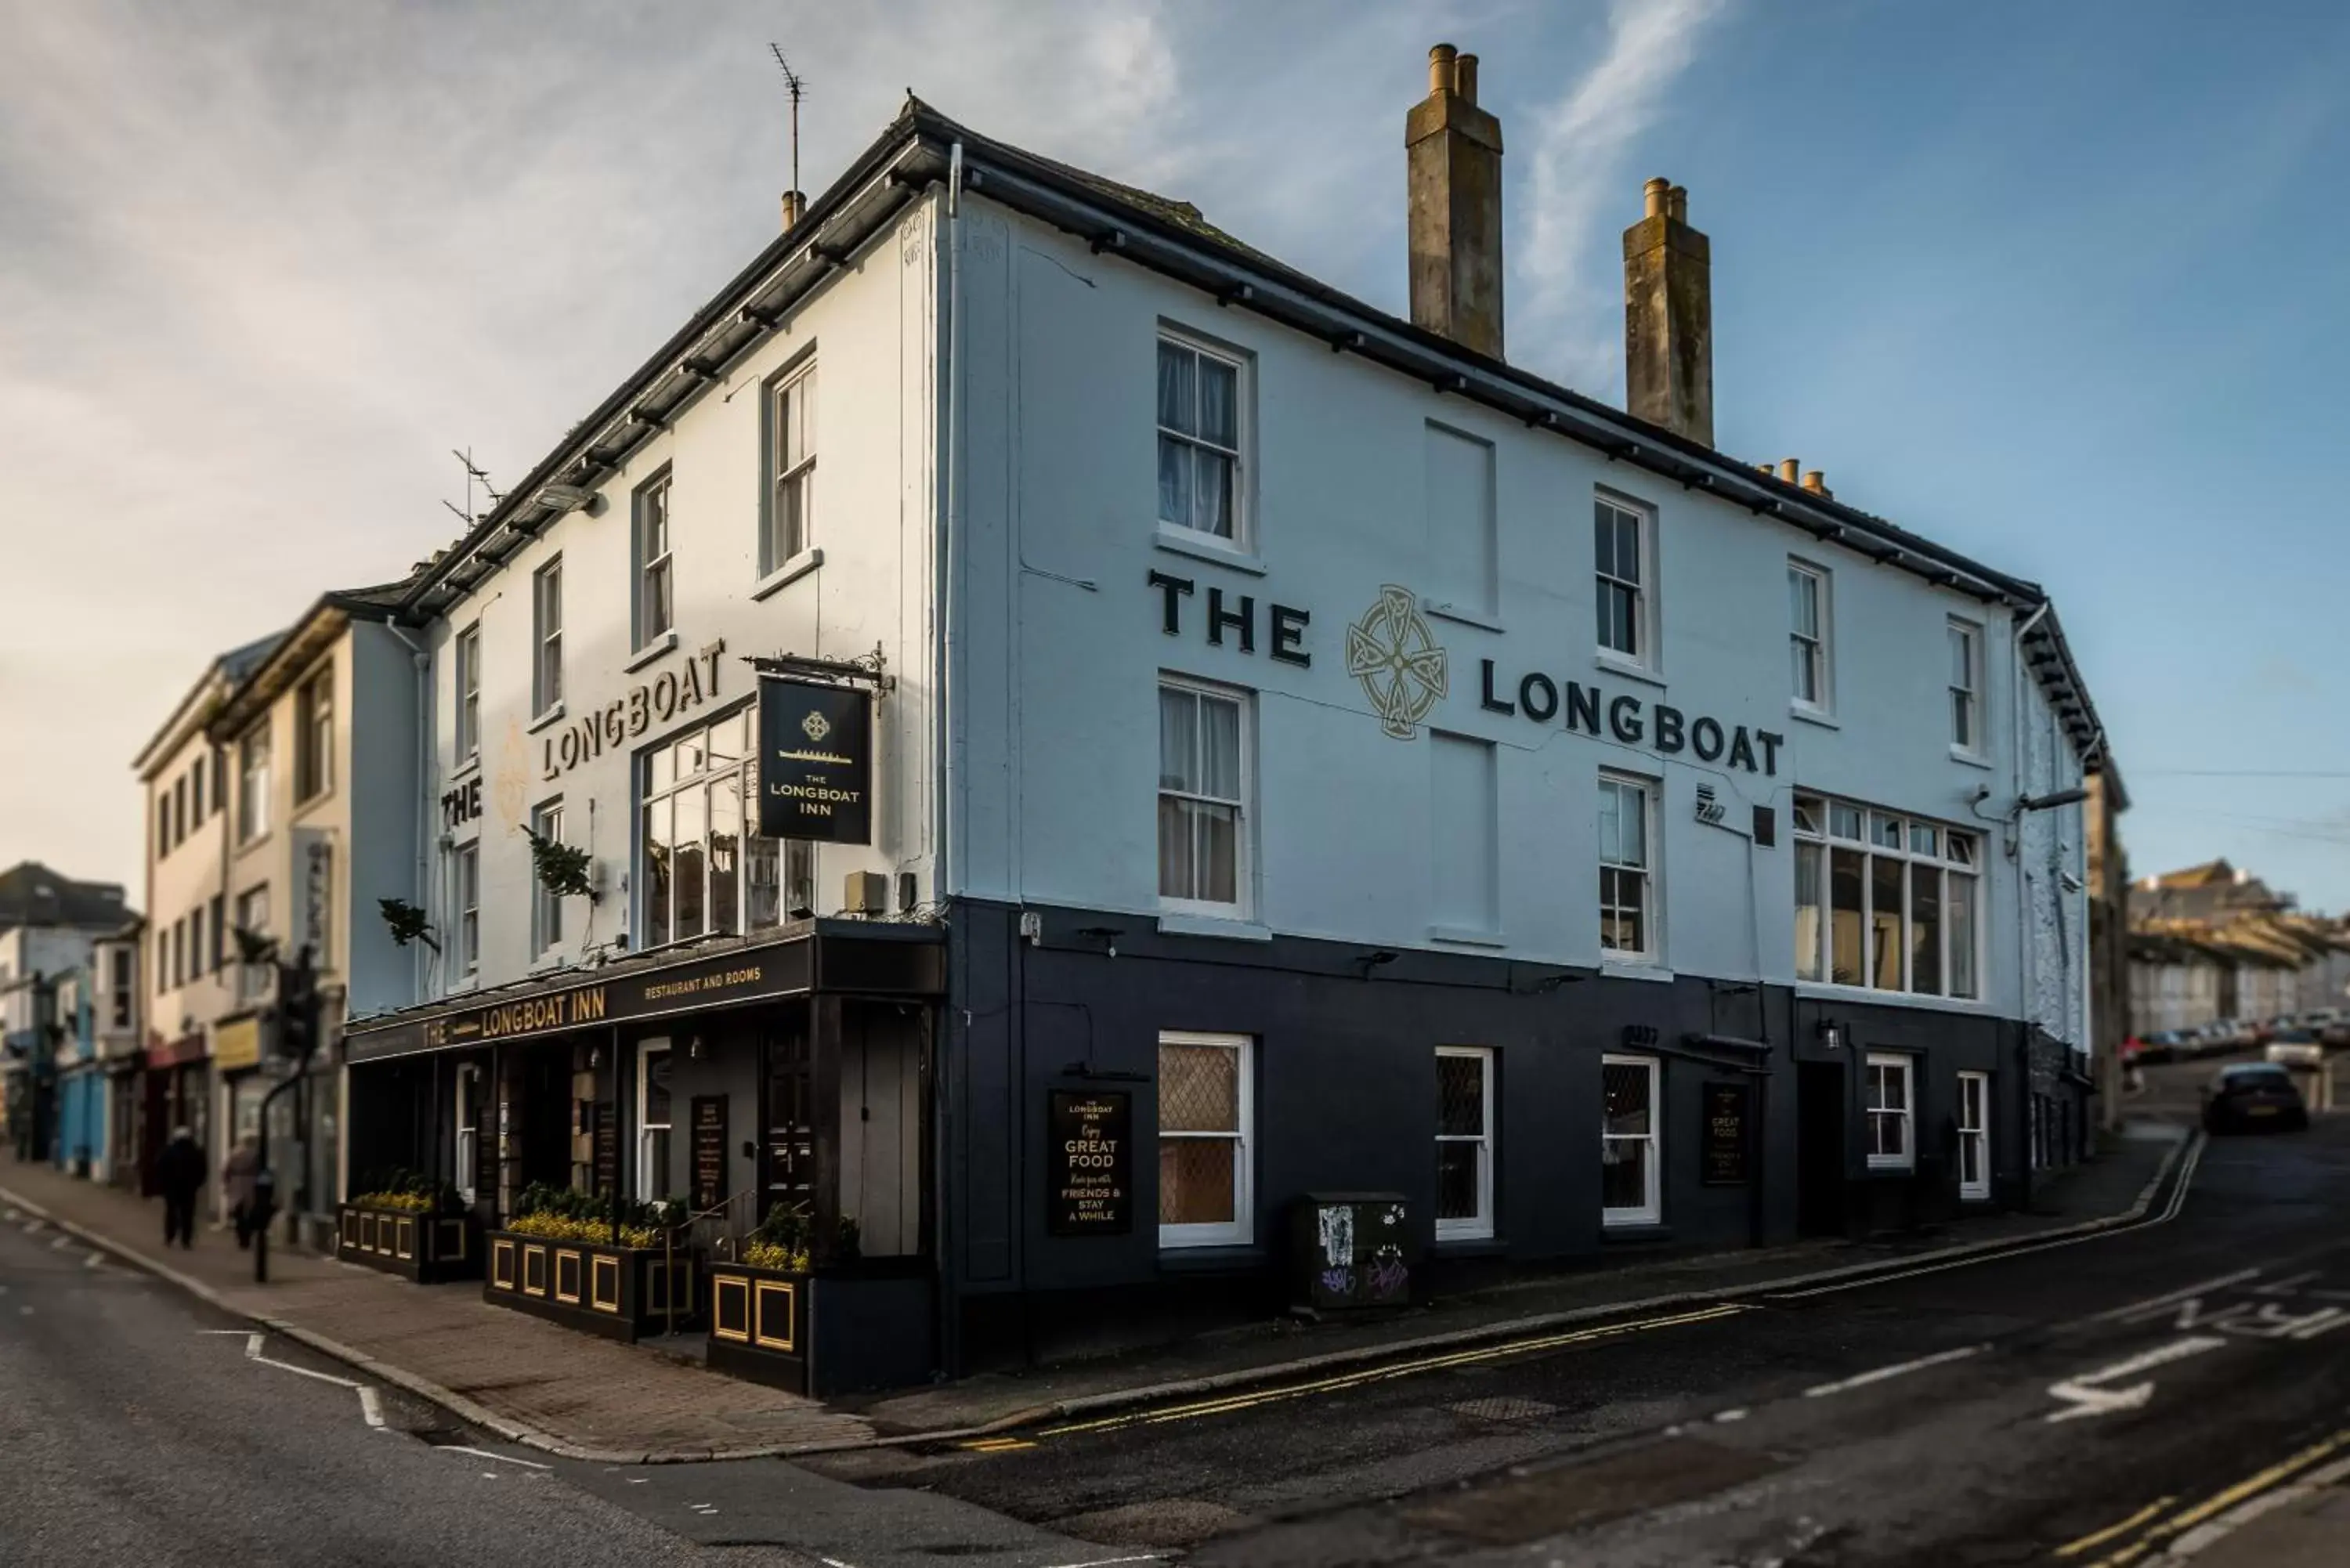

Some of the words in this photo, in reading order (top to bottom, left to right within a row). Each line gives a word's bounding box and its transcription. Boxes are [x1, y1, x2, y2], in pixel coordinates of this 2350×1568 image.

[1148, 569, 1311, 668] THE
[1480, 659, 1784, 775] LONGBOAT
[441, 775, 483, 826] THE
[542, 638, 725, 782] LONGBOAT
[805, 775, 826, 784] THE
[770, 781, 860, 803] LONGBOAT
[800, 802, 831, 815] INN
[645, 978, 701, 1000] RESTAURANT
[703, 974, 722, 990] AND
[726, 966, 761, 985] ROOMS
[423, 1021, 447, 1046] THE
[483, 995, 566, 1036] LONGBOAT
[572, 987, 605, 1021] INN
[1065, 1140, 1119, 1154] GREAT
[1068, 1154, 1114, 1168] FOOD
[1061, 1188, 1110, 1198] FRIENDS
[1078, 1199, 1104, 1210] STAY
[1068, 1211, 1077, 1222] A
[1079, 1210, 1115, 1222] WHILE
